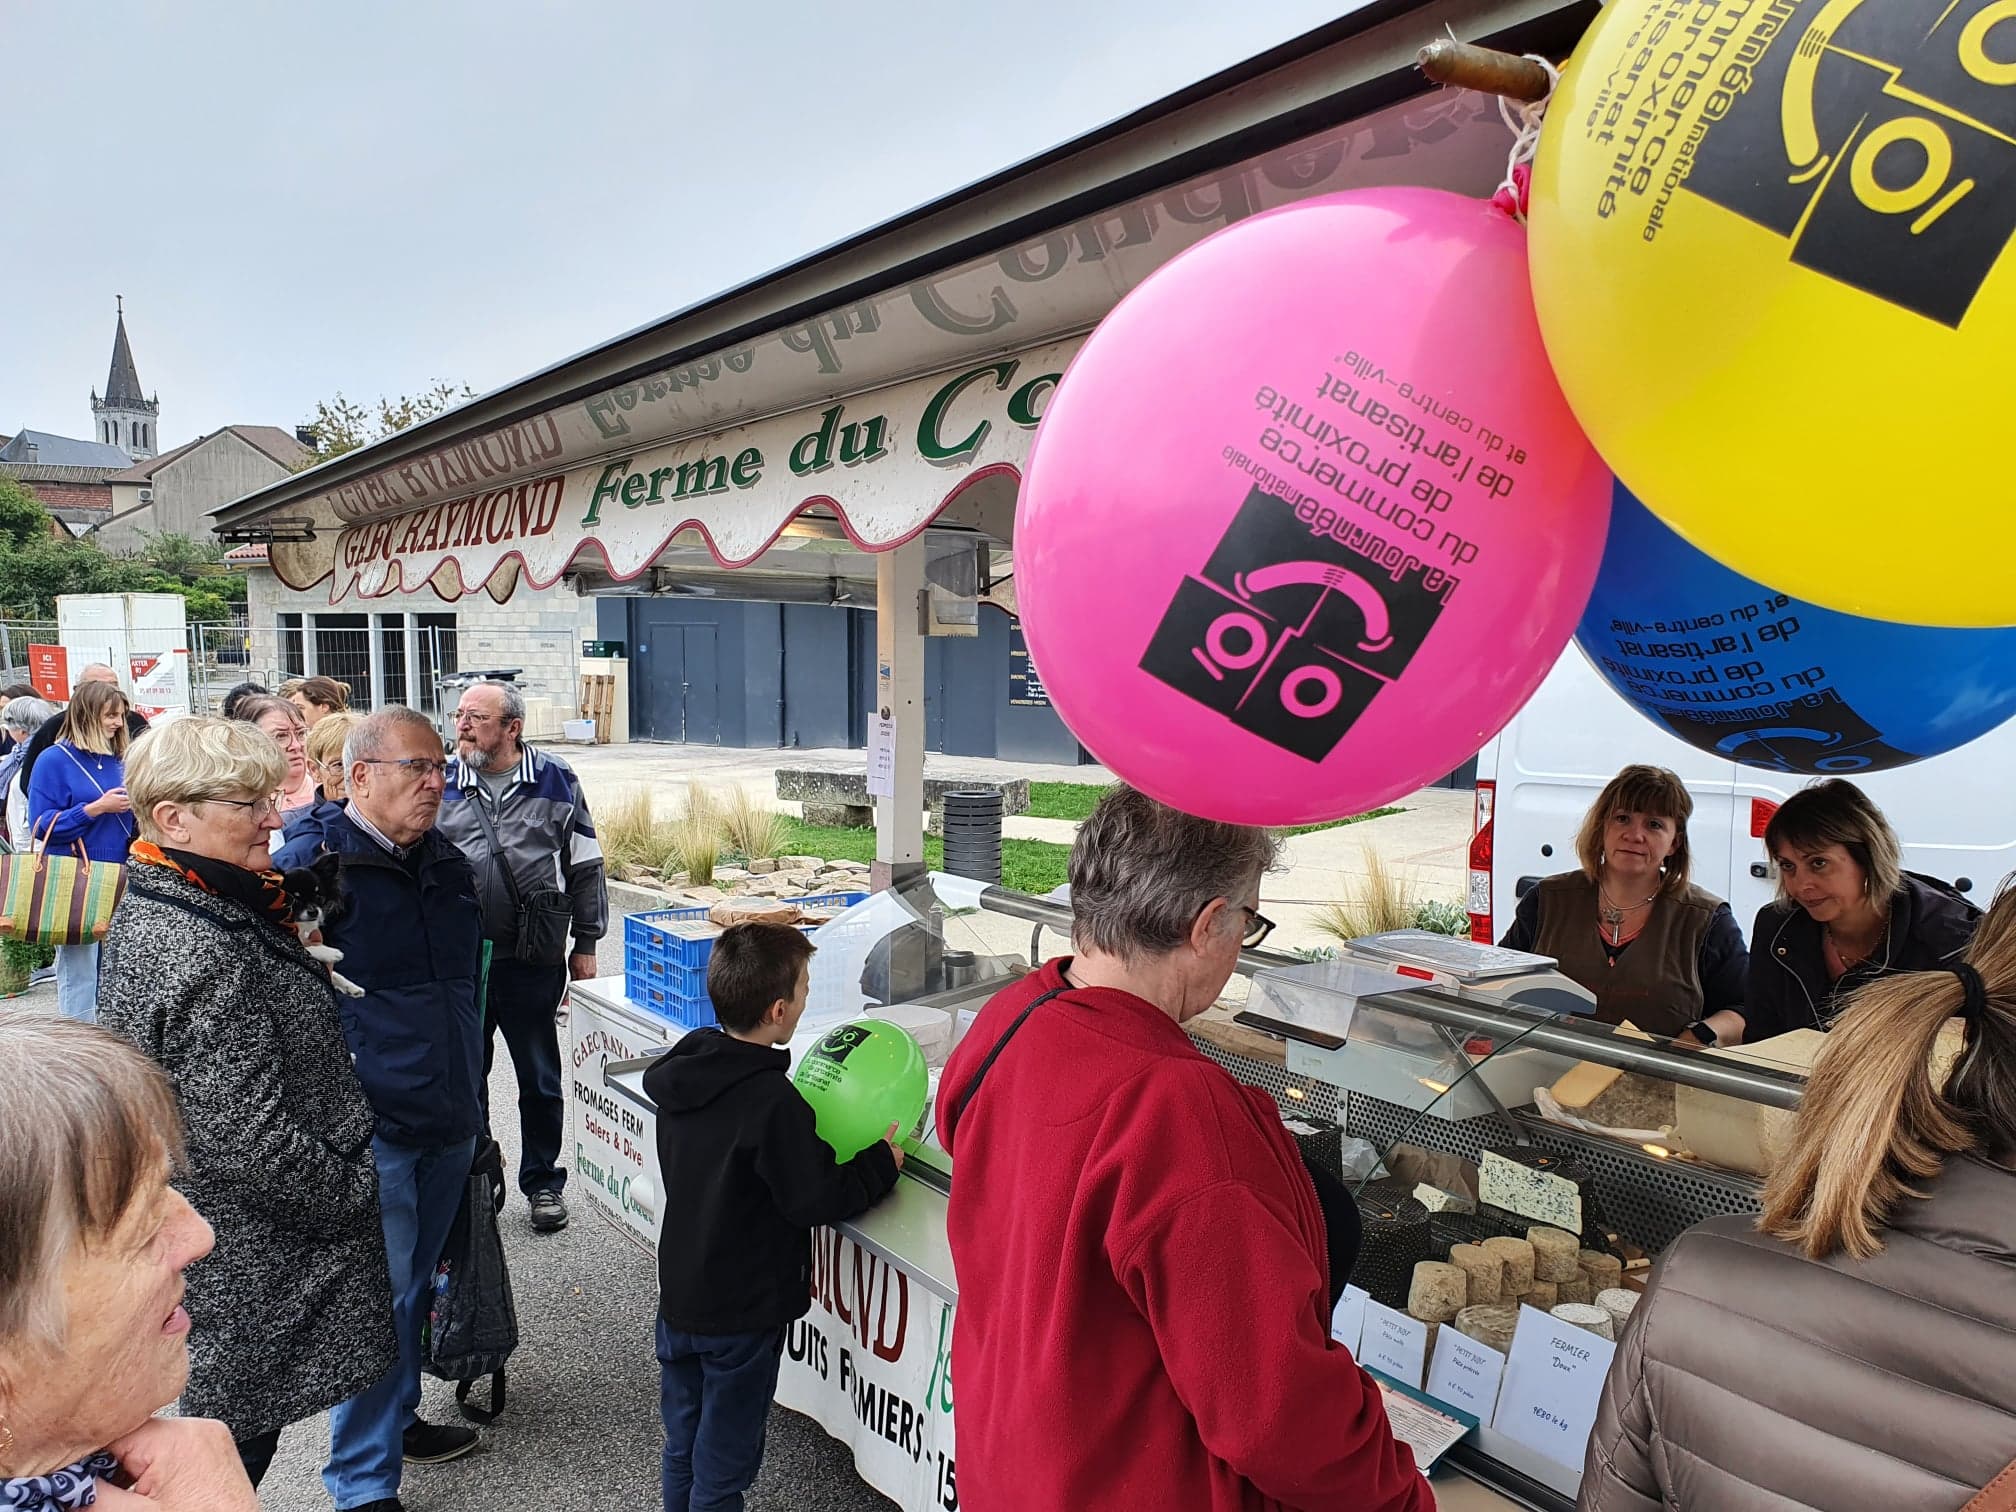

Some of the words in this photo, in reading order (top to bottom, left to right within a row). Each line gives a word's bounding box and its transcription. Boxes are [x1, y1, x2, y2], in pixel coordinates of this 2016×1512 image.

[1597, 0, 1720, 219] proximité
[1643, 121, 1705, 242] nationale
[1255, 385, 1413, 487] proximité
[1476, 427, 1503, 452] du
[1506, 444, 1527, 464] et
[344, 516, 403, 569] GAEC
[395, 475, 566, 554] RAYMOND
[581, 445, 764, 528] Ferme
[789, 404, 888, 478] du
[1221, 444, 1297, 500] nationale
[1259, 427, 1436, 541] commerce
[1476, 464, 1515, 499] de
[1410, 482, 1453, 514] de
[1294, 498, 1420, 582] Journée
[1437, 531, 1480, 567] du
[1422, 563, 1461, 605] La
[1730, 604, 1759, 622] du
[1764, 594, 1790, 613] et
[1757, 617, 1800, 641] de
[1602, 656, 1719, 685] proximité
[1724, 661, 1764, 682] de
[1781, 666, 1825, 689] du
[1627, 681, 1775, 703] commerce
[573, 1031, 600, 1068] GAEC
[574, 1080, 619, 1123] FROMAGES
[585, 1113, 610, 1144] Salers
[614, 1132, 620, 1151] &
[623, 1138, 644, 1168] Dive
[576, 1142, 605, 1187] Ferme
[608, 1165, 619, 1200] du
[1551, 1337, 1590, 1361] FERMIER
